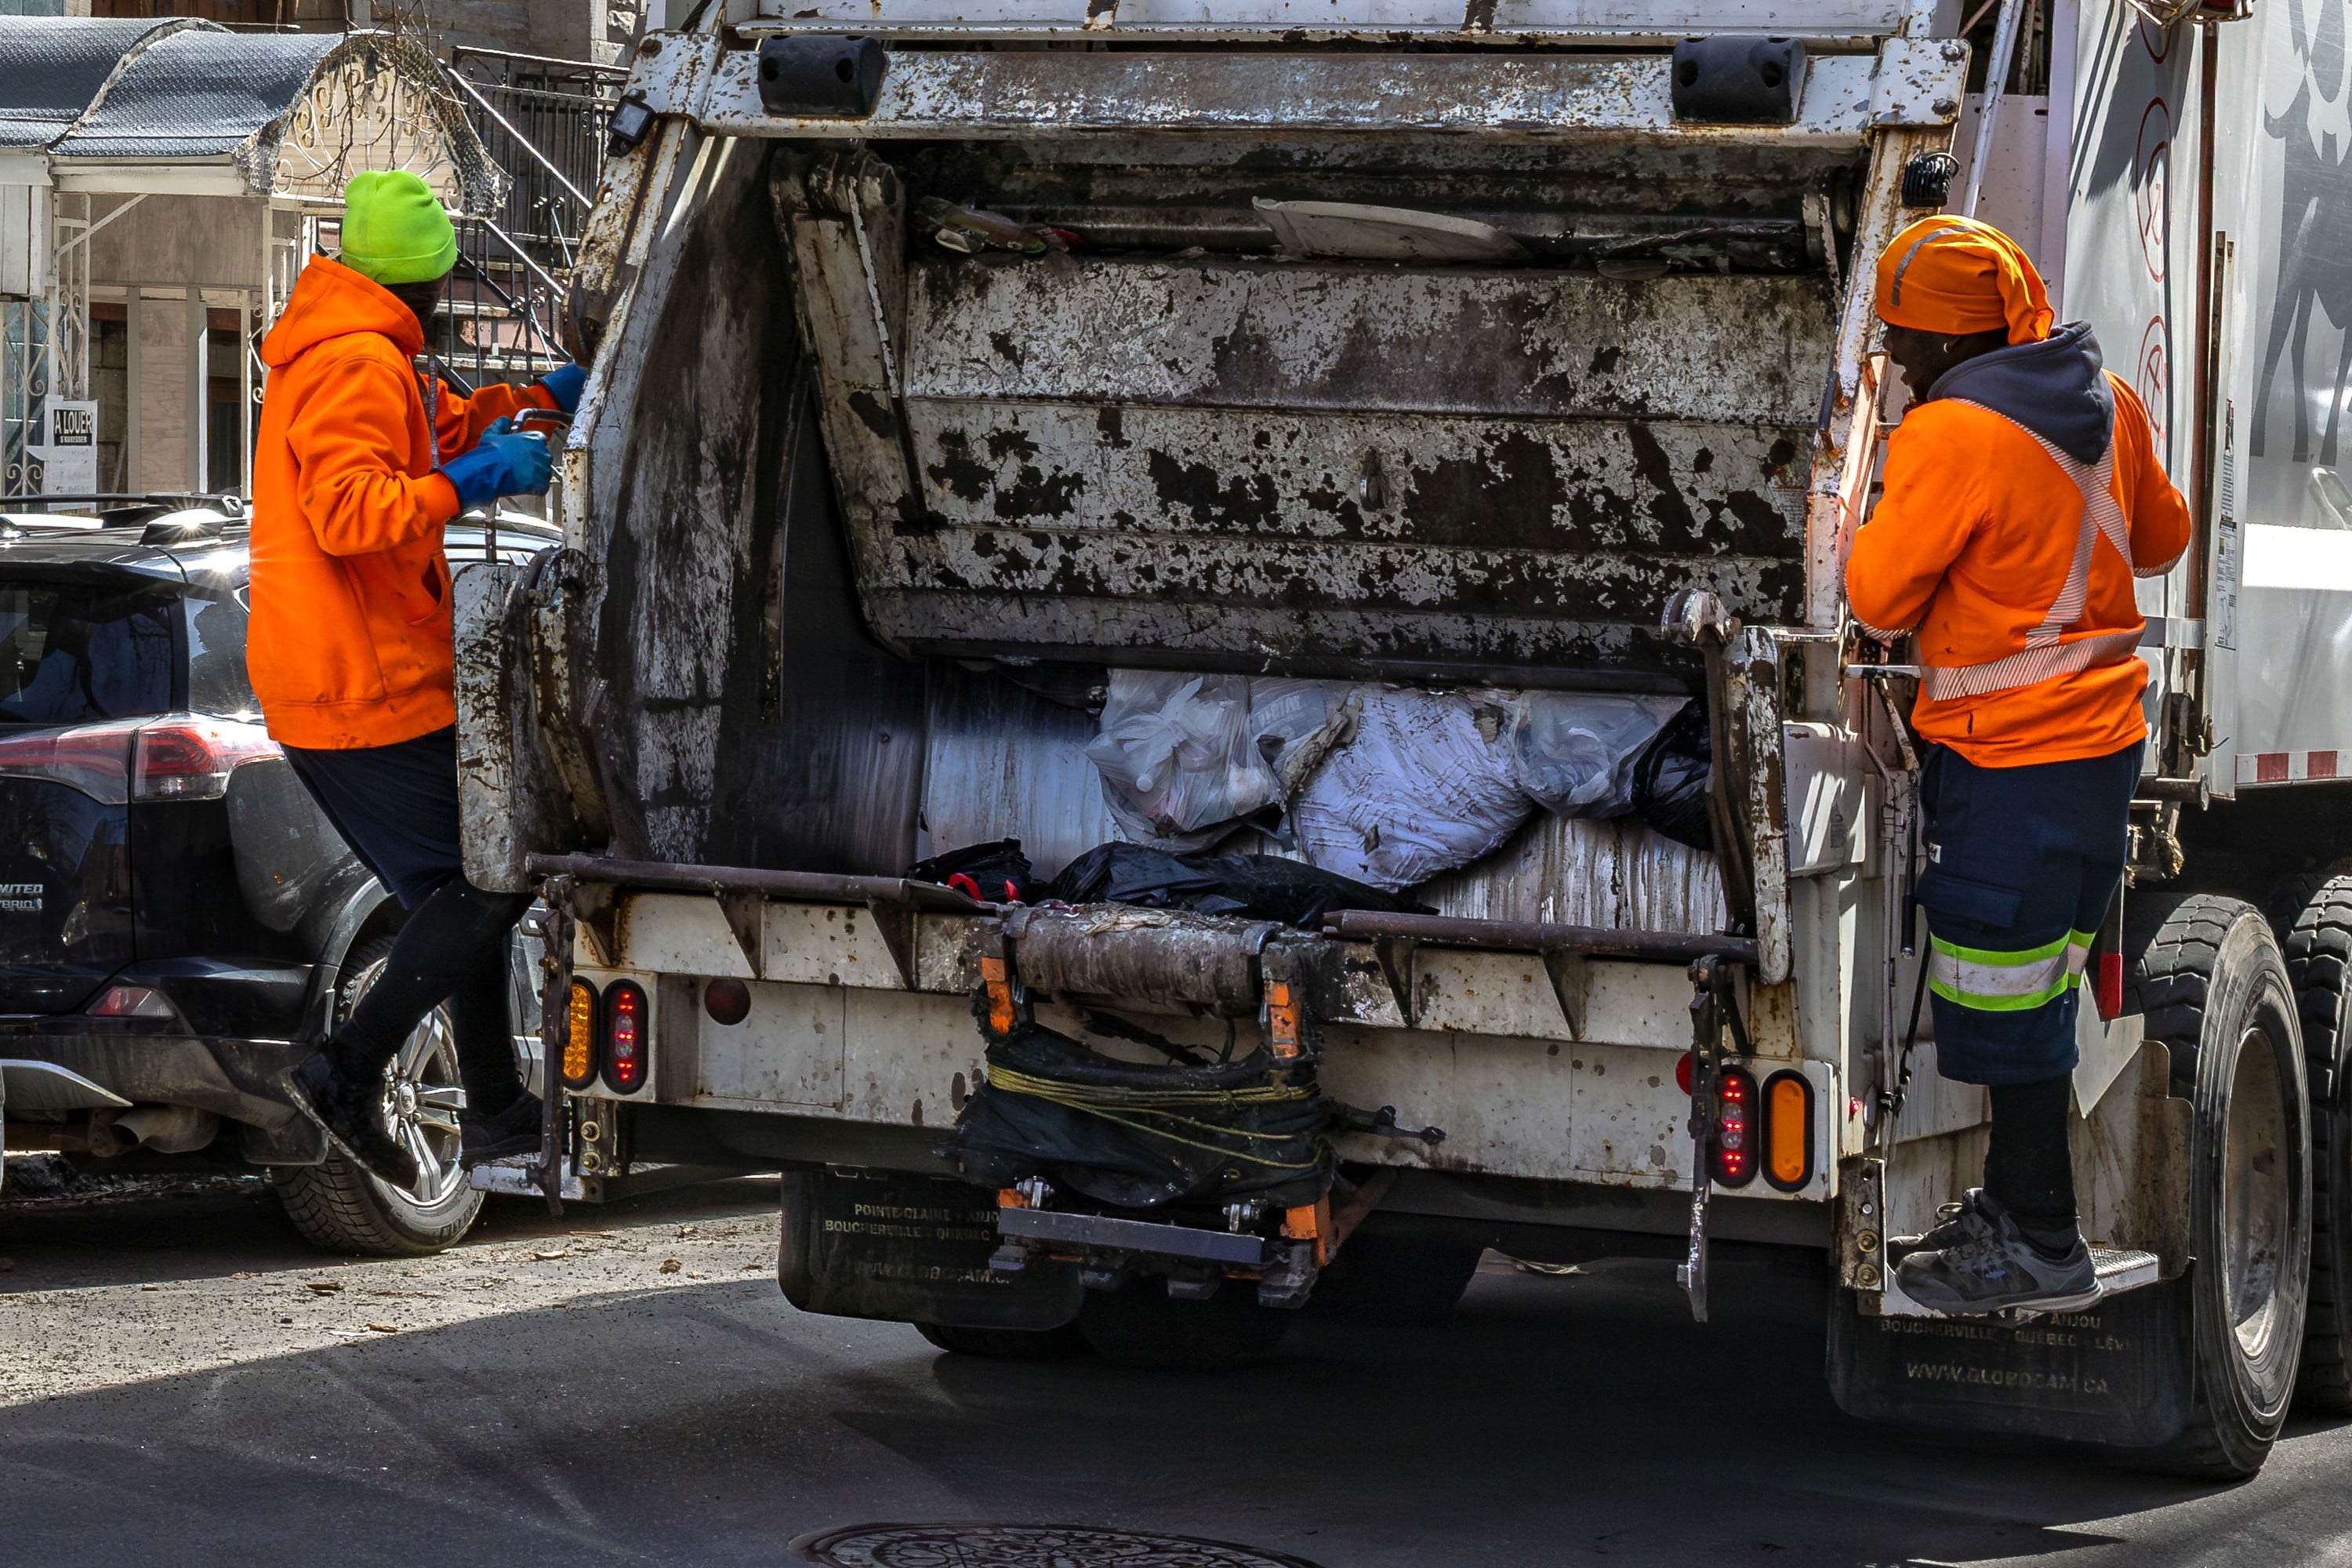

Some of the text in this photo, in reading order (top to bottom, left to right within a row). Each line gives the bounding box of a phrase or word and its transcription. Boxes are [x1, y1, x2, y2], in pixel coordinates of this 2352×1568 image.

[55, 411, 93, 434] A LOUER
[0, 899, 34, 909] BRID
[2051, 1312, 2101, 1330] ANJOU
